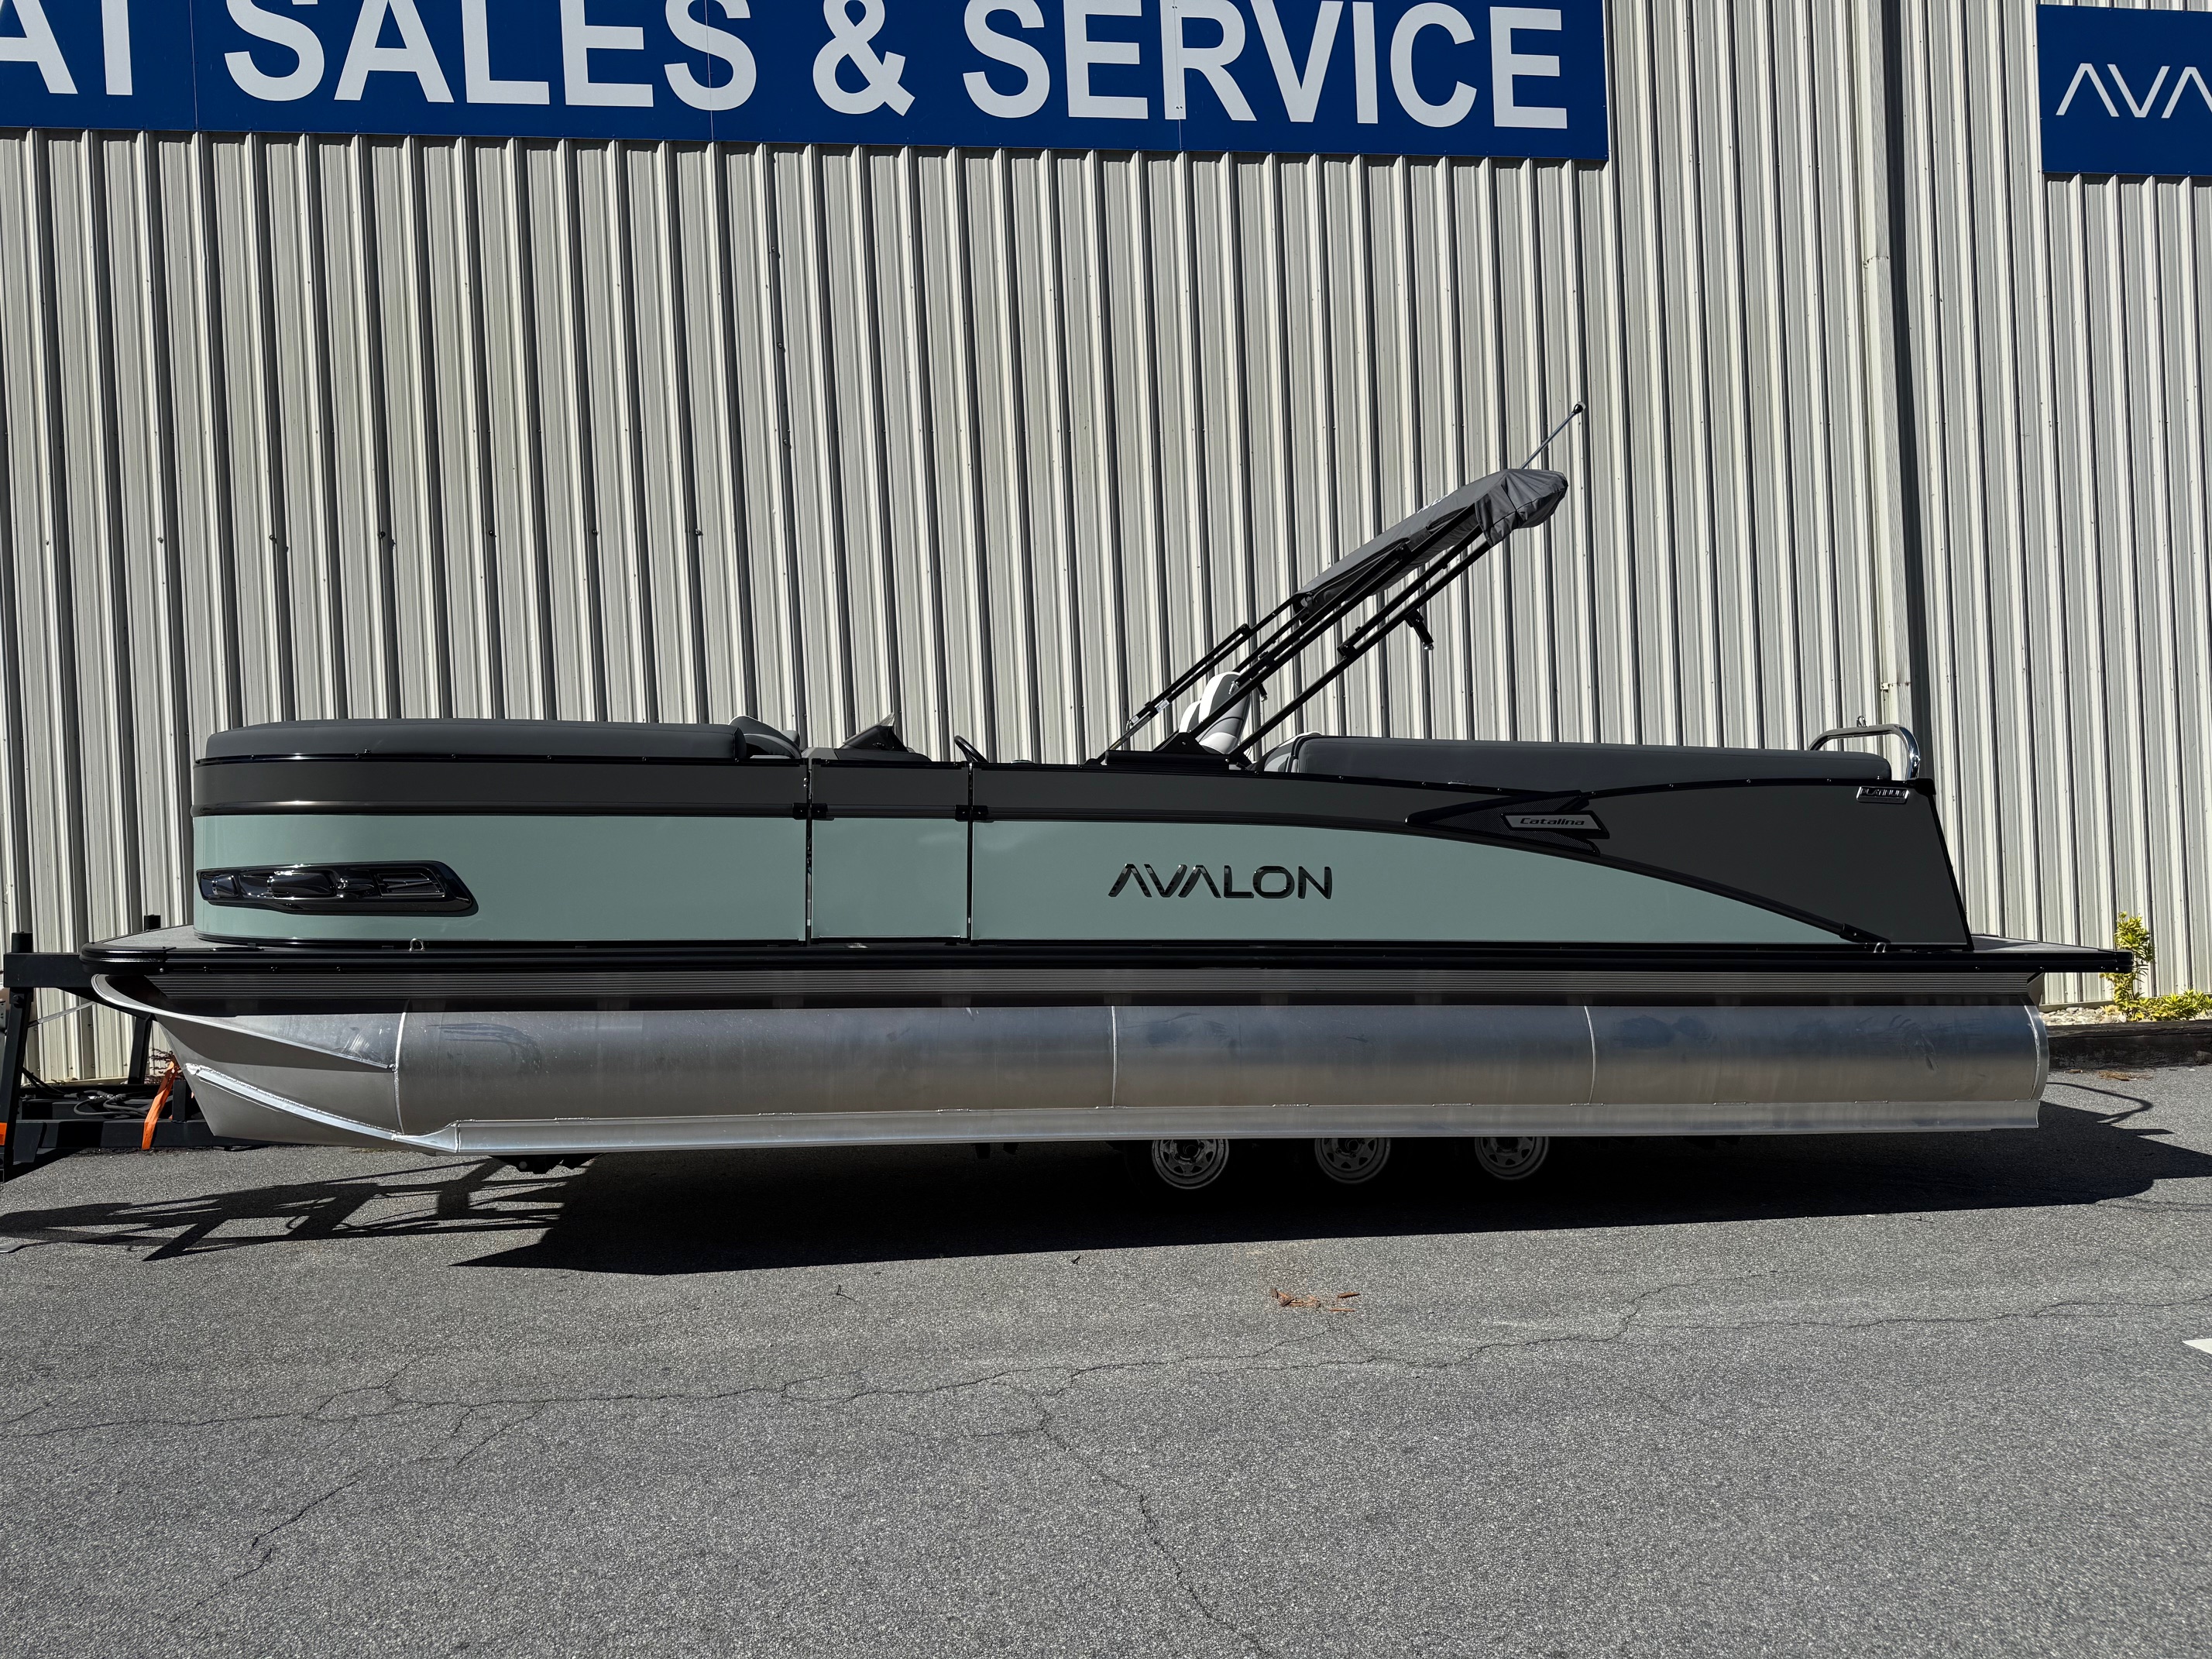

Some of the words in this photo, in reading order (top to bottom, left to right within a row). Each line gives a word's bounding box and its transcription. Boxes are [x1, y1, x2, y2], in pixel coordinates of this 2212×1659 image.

[225, 0, 757, 111] SALES
[812, 0, 915, 117] &
[963, 0, 1568, 129] SERVICE
[1860, 788, 1906, 797] PLATINUM
[1520, 817, 1585, 826] Catalina
[1108, 863, 1333, 900] AVALON
